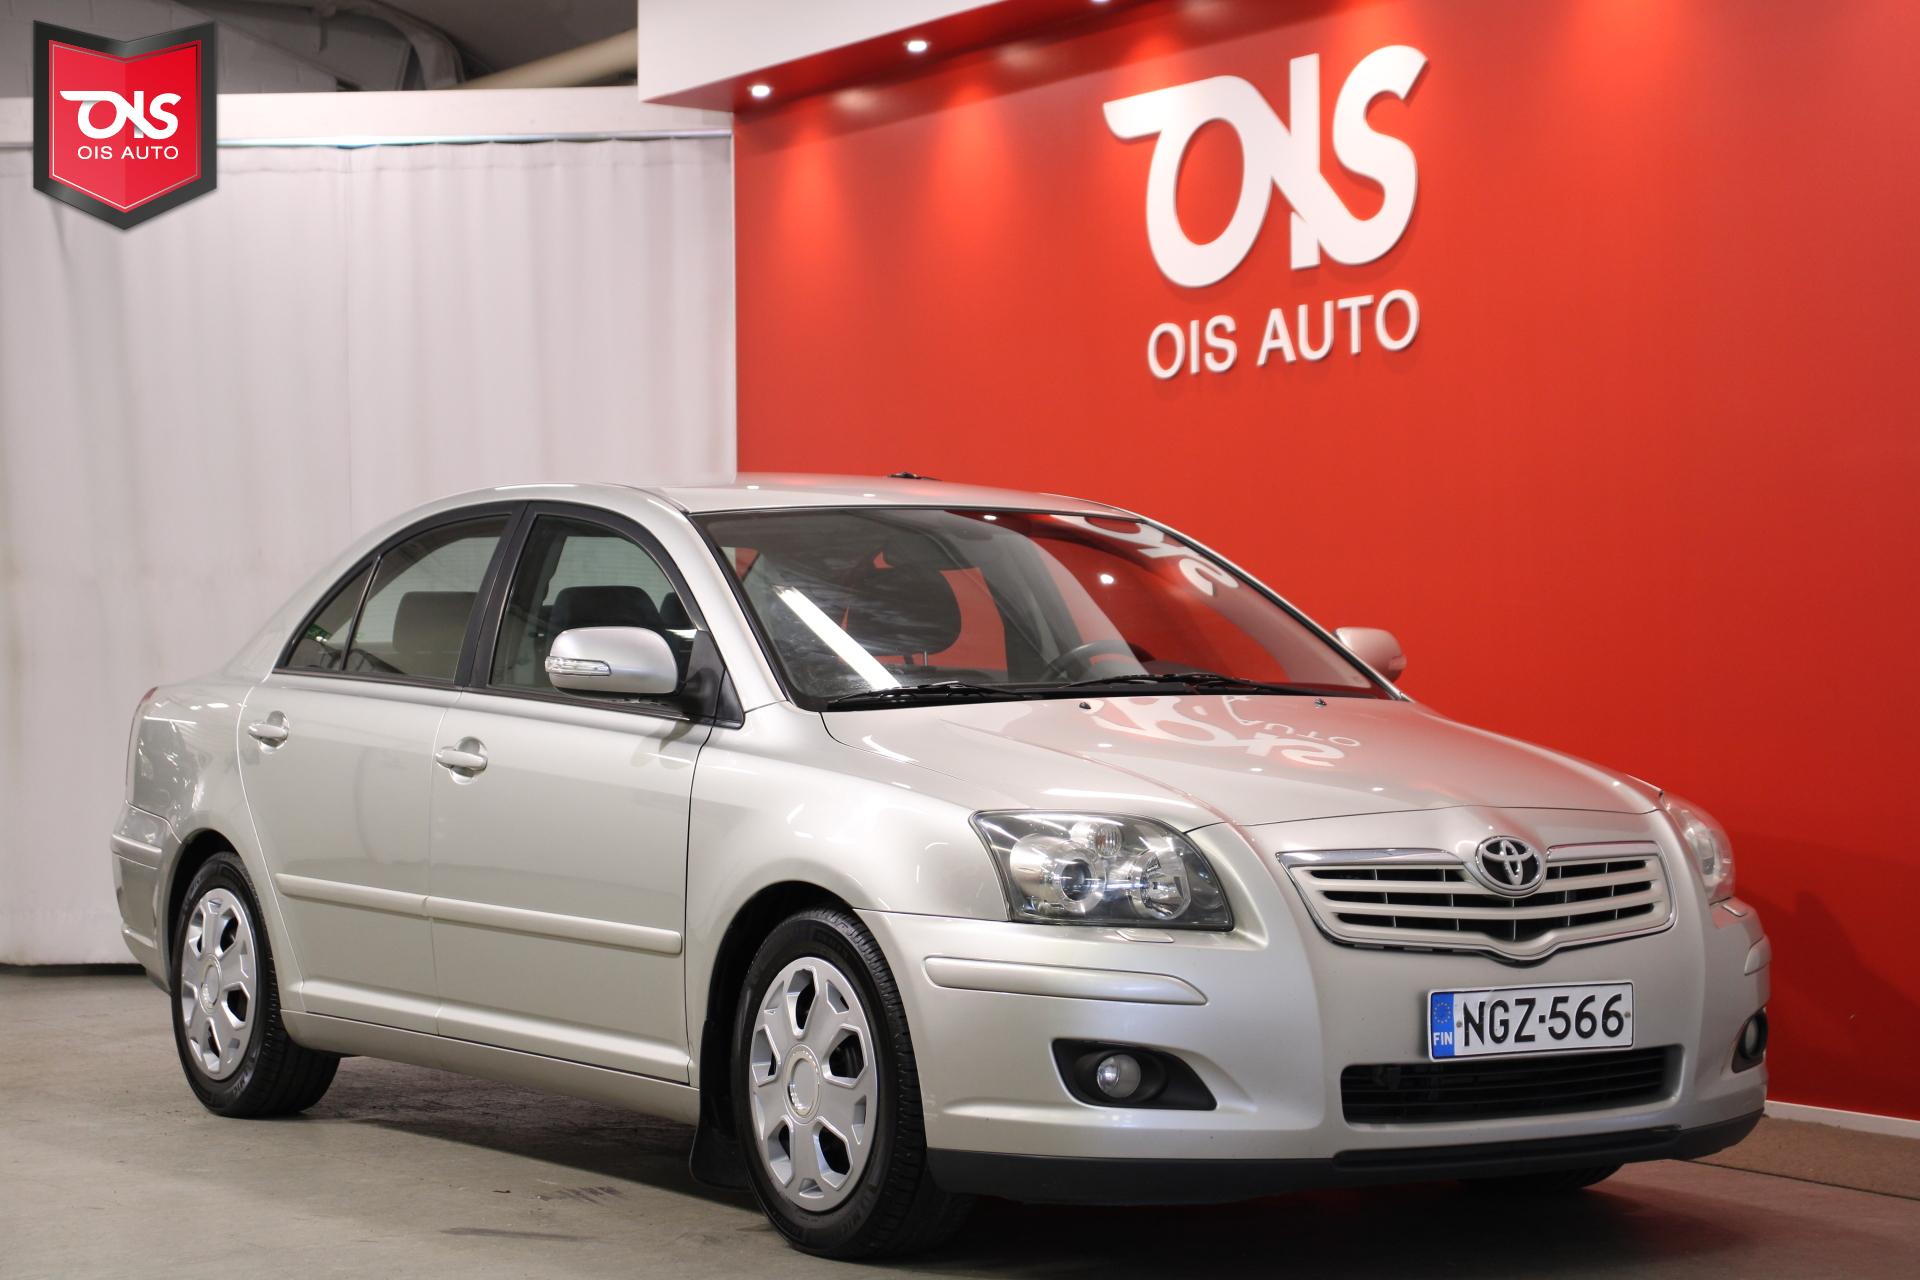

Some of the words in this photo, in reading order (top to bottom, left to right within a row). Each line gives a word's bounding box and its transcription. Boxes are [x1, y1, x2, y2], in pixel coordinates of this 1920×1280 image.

[1103, 45, 1427, 288] OIS
[1148, 315, 1237, 378] OIS
[1257, 290, 1419, 365] AUTO
[1433, 1031, 1453, 1046] FIN
[1463, 994, 1625, 1047] NGZ-566
